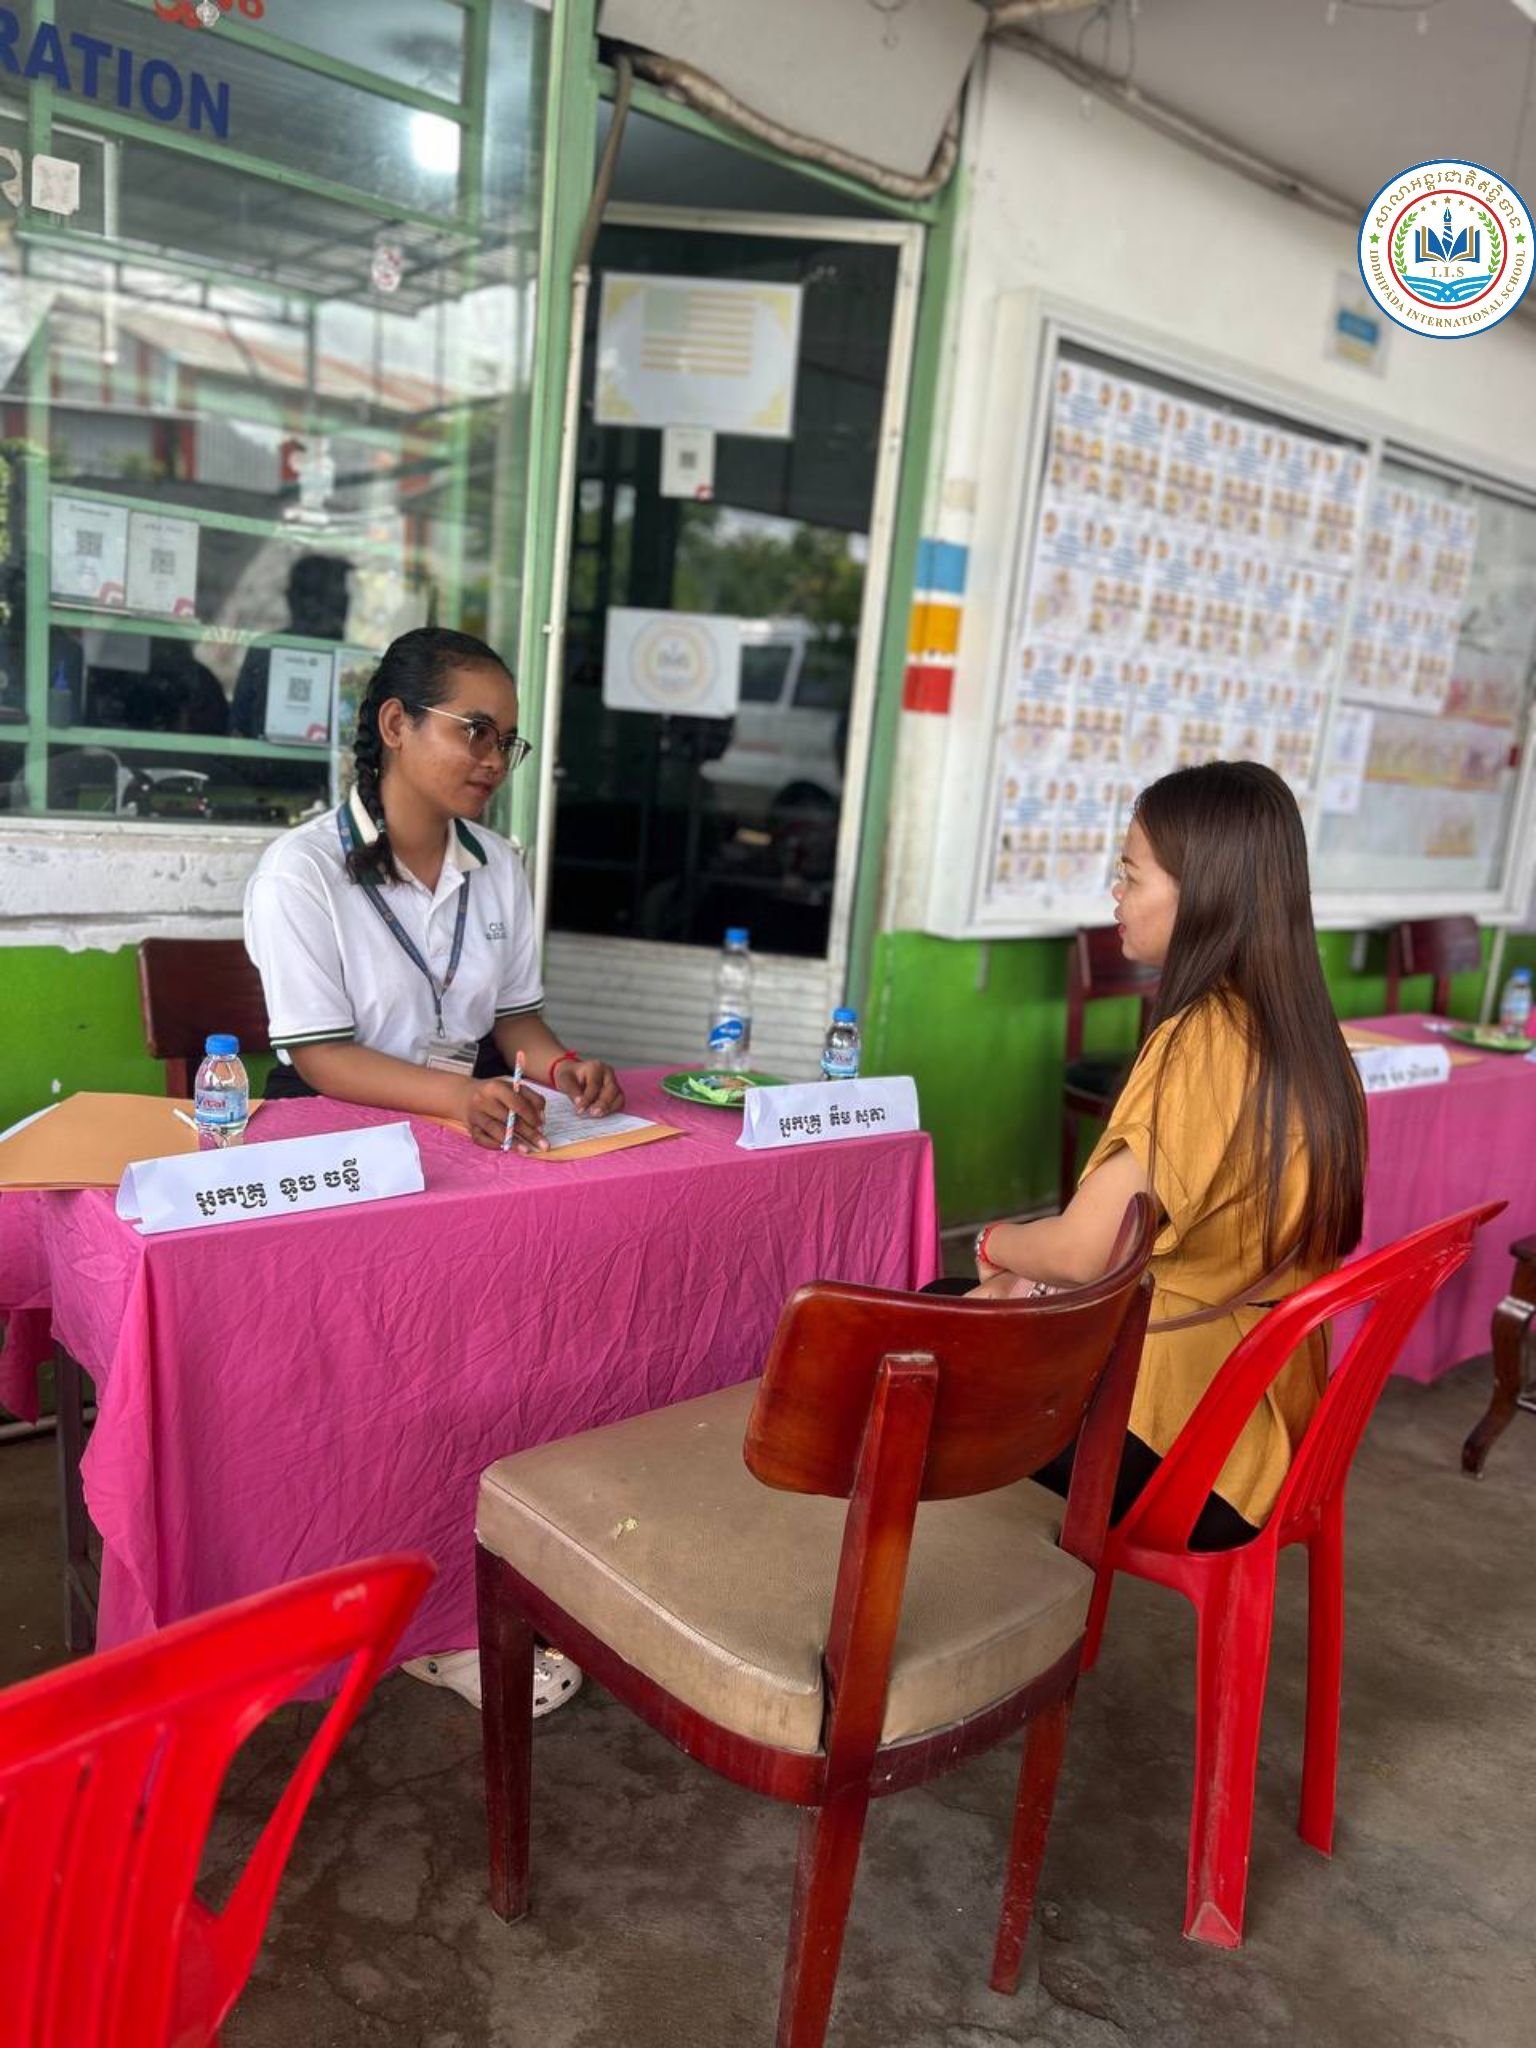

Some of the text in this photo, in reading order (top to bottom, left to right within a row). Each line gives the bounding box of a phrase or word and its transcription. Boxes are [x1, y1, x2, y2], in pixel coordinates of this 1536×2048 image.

[196, 1182, 268, 1216] អ្នកគ្រូ
[280, 1174, 317, 1202] ទូច
